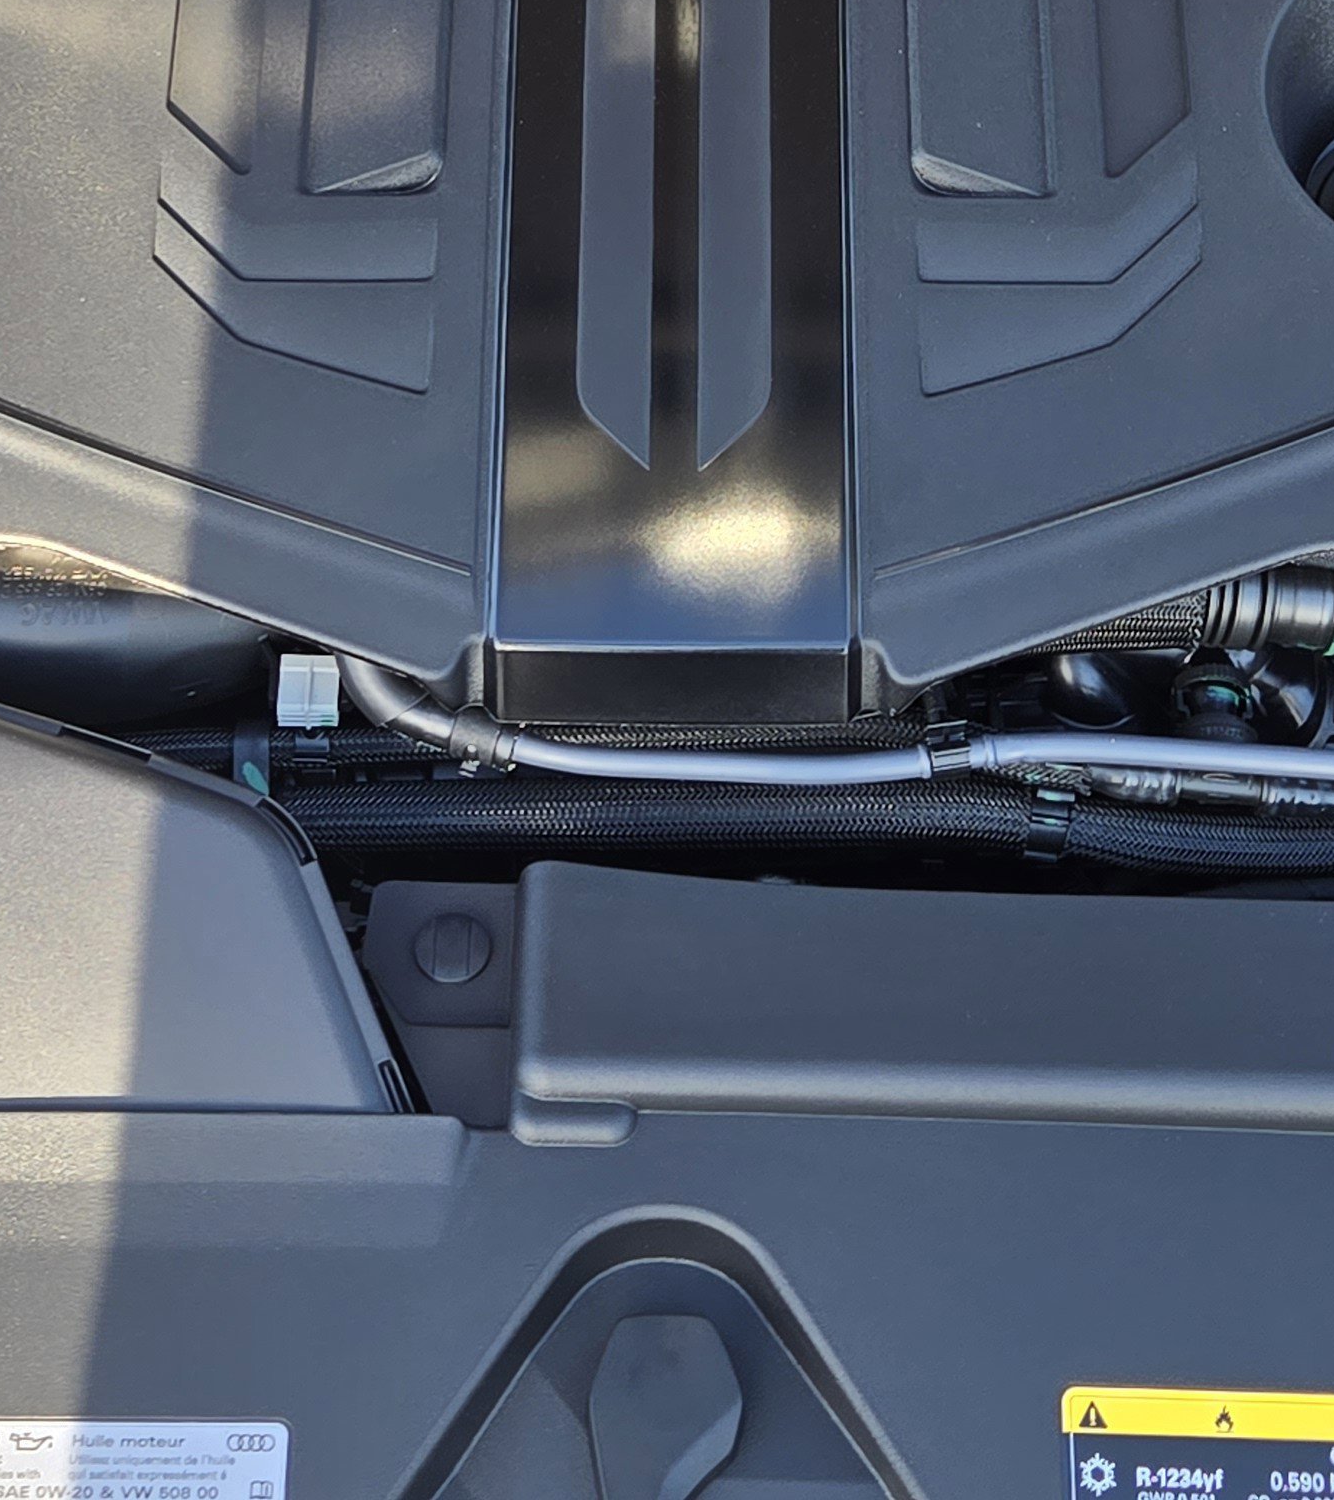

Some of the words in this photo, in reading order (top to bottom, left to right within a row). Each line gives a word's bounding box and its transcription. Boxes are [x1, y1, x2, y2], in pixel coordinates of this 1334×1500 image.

[72, 1434, 115, 1448] Huile
[120, 1436, 186, 1449] moteur
[1135, 1466, 1224, 1493] R-1234yf
[35, 1486, 94, 1499] 0W-20
[99, 1486, 113, 1498] &
[120, 1486, 153, 1499] VW
[158, 1486, 191, 1499] 508
[197, 1486, 219, 1499] 00
